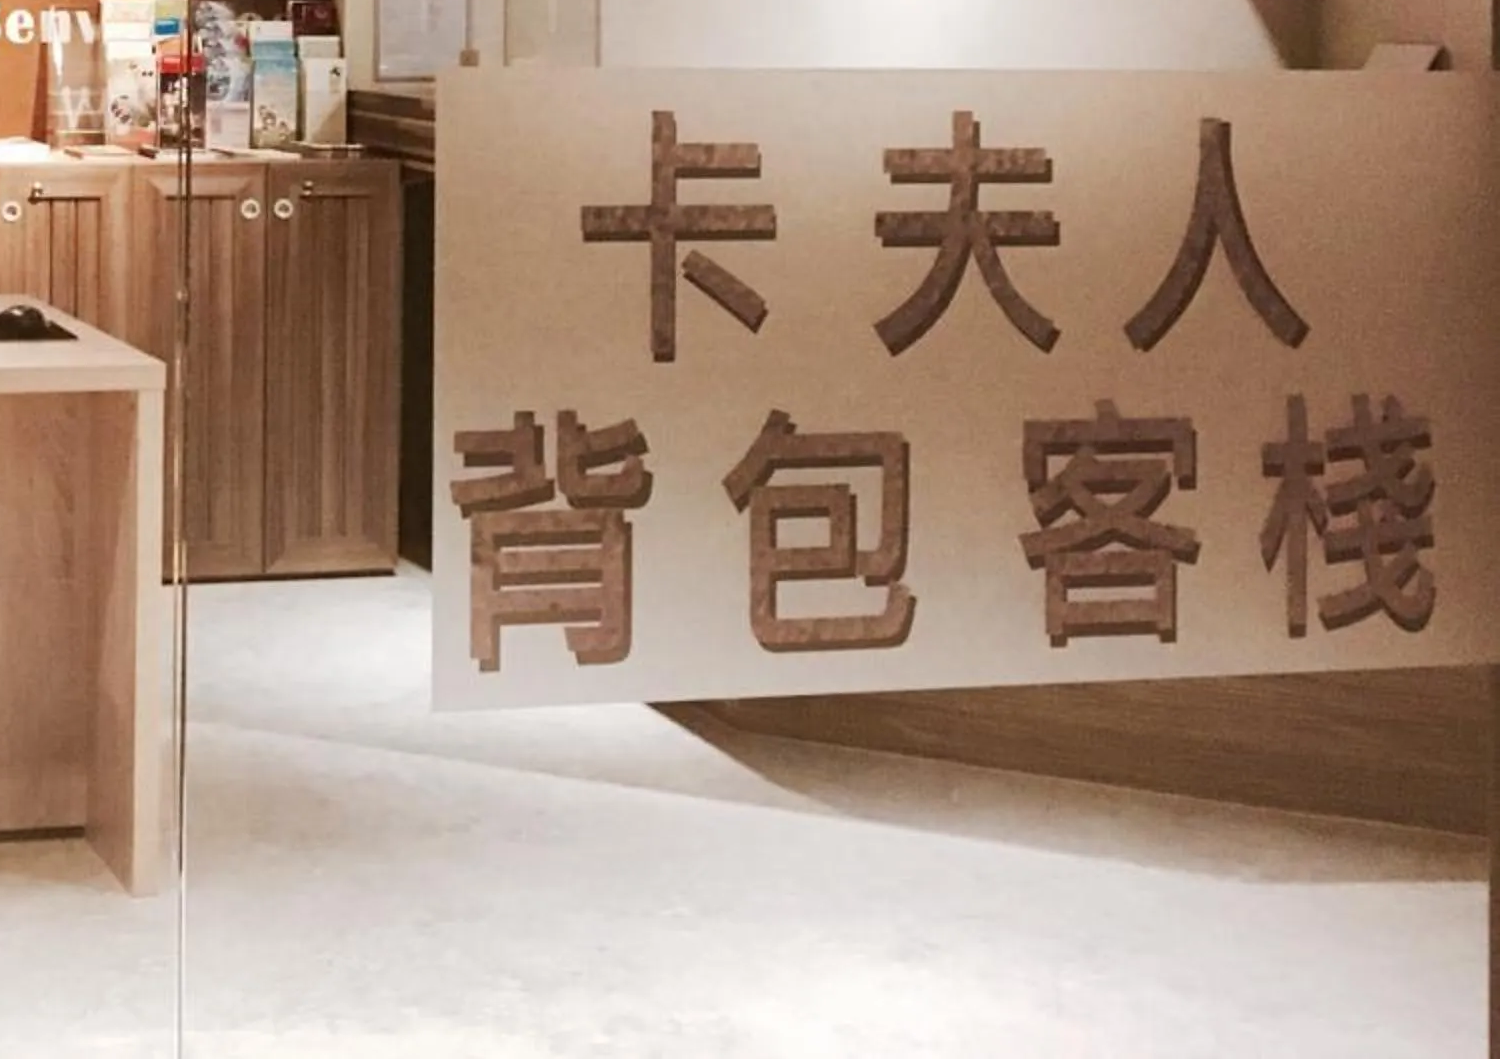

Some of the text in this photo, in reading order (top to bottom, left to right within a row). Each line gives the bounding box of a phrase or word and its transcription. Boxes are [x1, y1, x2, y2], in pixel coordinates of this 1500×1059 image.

[580, 110, 1310, 364] 卡夫人
[450, 391, 1437, 673] 背包客棧
